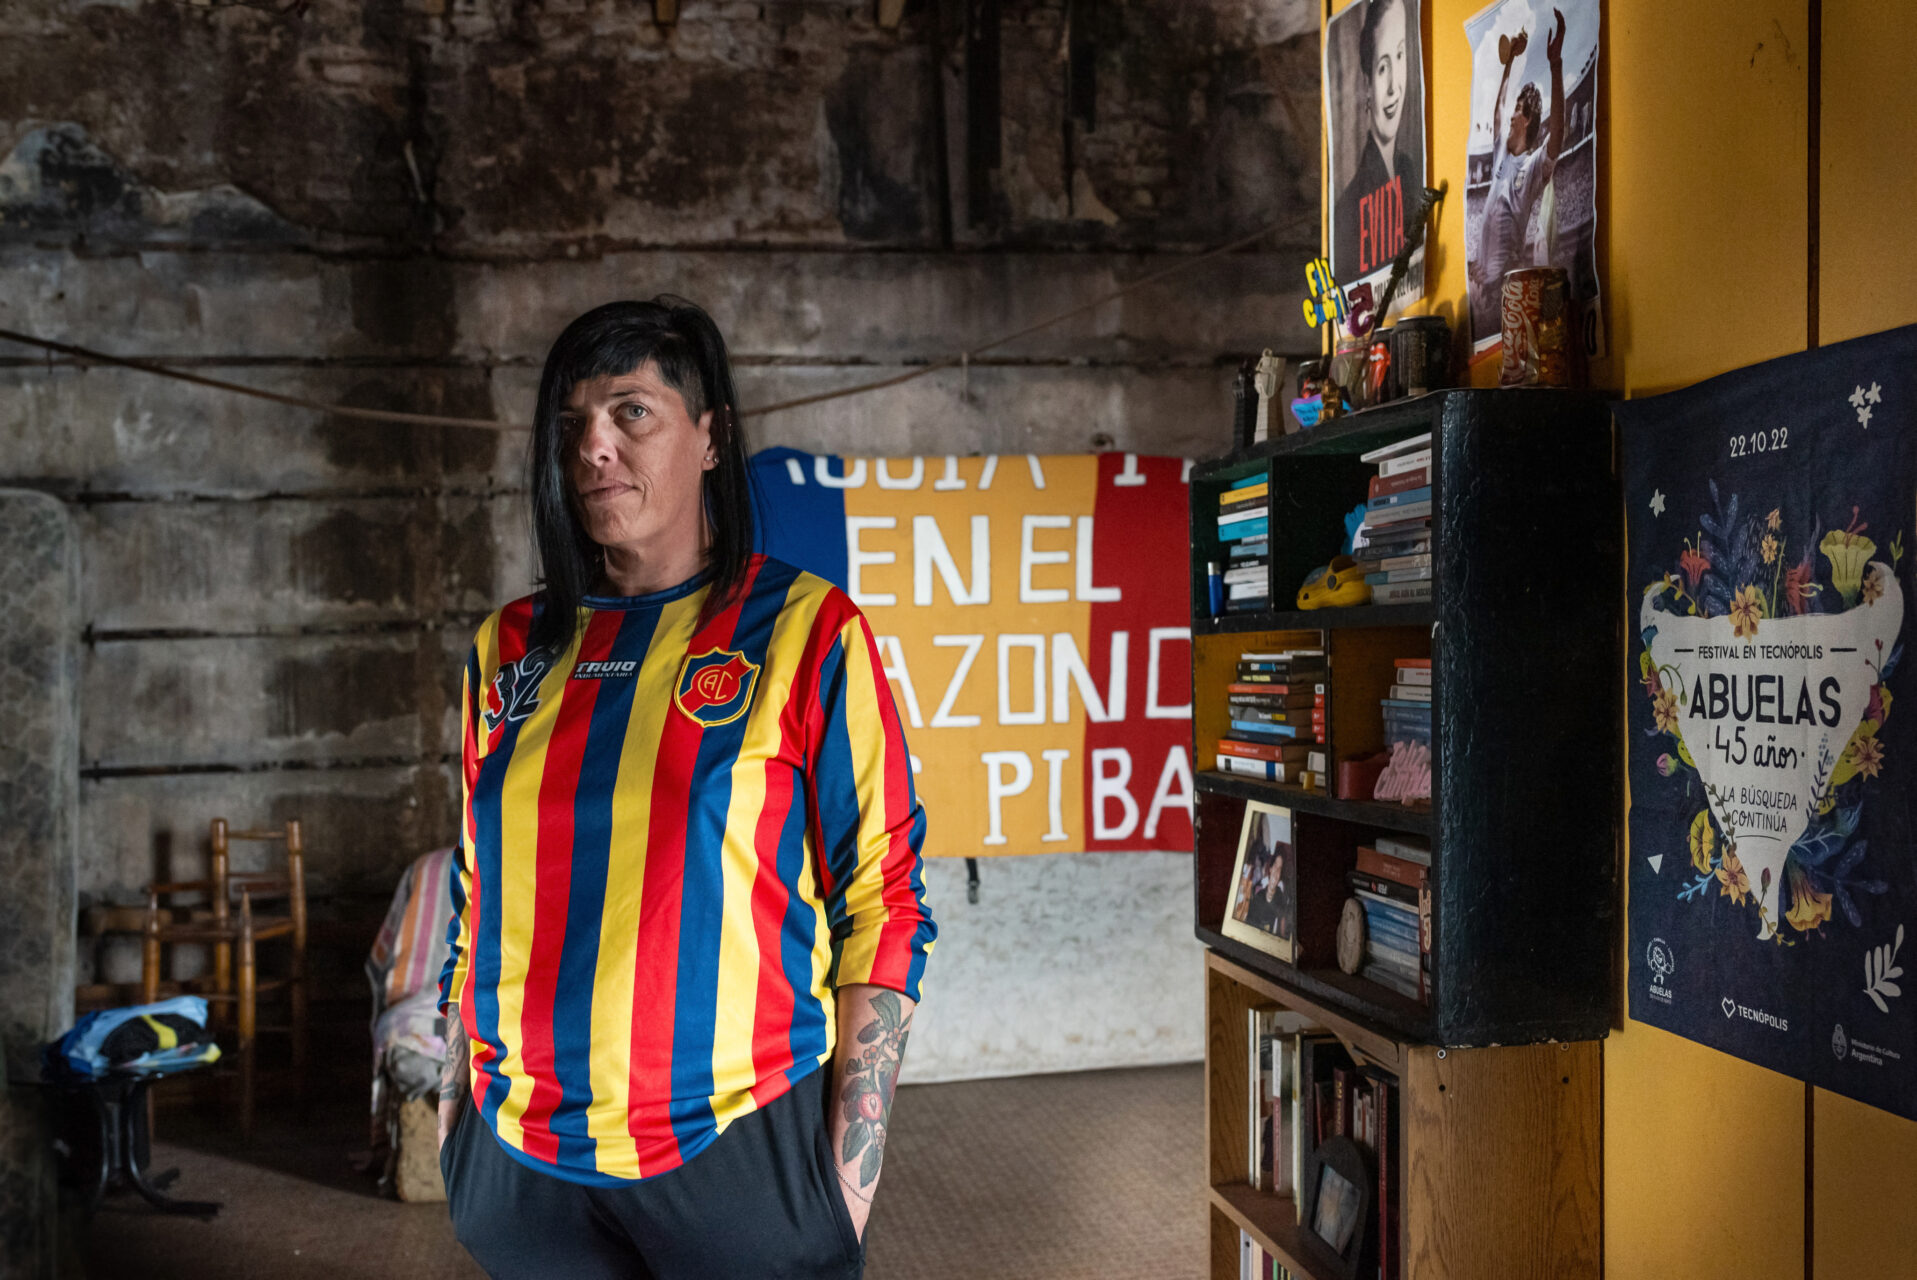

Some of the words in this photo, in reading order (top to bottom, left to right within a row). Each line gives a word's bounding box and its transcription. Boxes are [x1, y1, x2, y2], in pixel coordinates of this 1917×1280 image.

[1360, 175, 1404, 272] EVITA
[1730, 427, 1788, 457] 22.10.22
[847, 515, 991, 606] EN
[1020, 515, 1121, 604] EL
[1699, 645, 1740, 659] FESTIVAL
[1743, 645, 1757, 659] EN
[1760, 641, 1823, 659] TECNÓPOLIS
[1689, 673, 1841, 728] ABUELAS
[1715, 725, 1747, 765] 45
[1753, 735, 1798, 770] años
[1741, 785, 1798, 811] BÚSQUEDA
[1731, 810, 1788, 833] CONTINÚA
[1650, 985, 1673, 999] ABUELAS
[1738, 1005, 1788, 1031] TECNÓPOLIS
[1851, 1048, 1883, 1066] Argentina
